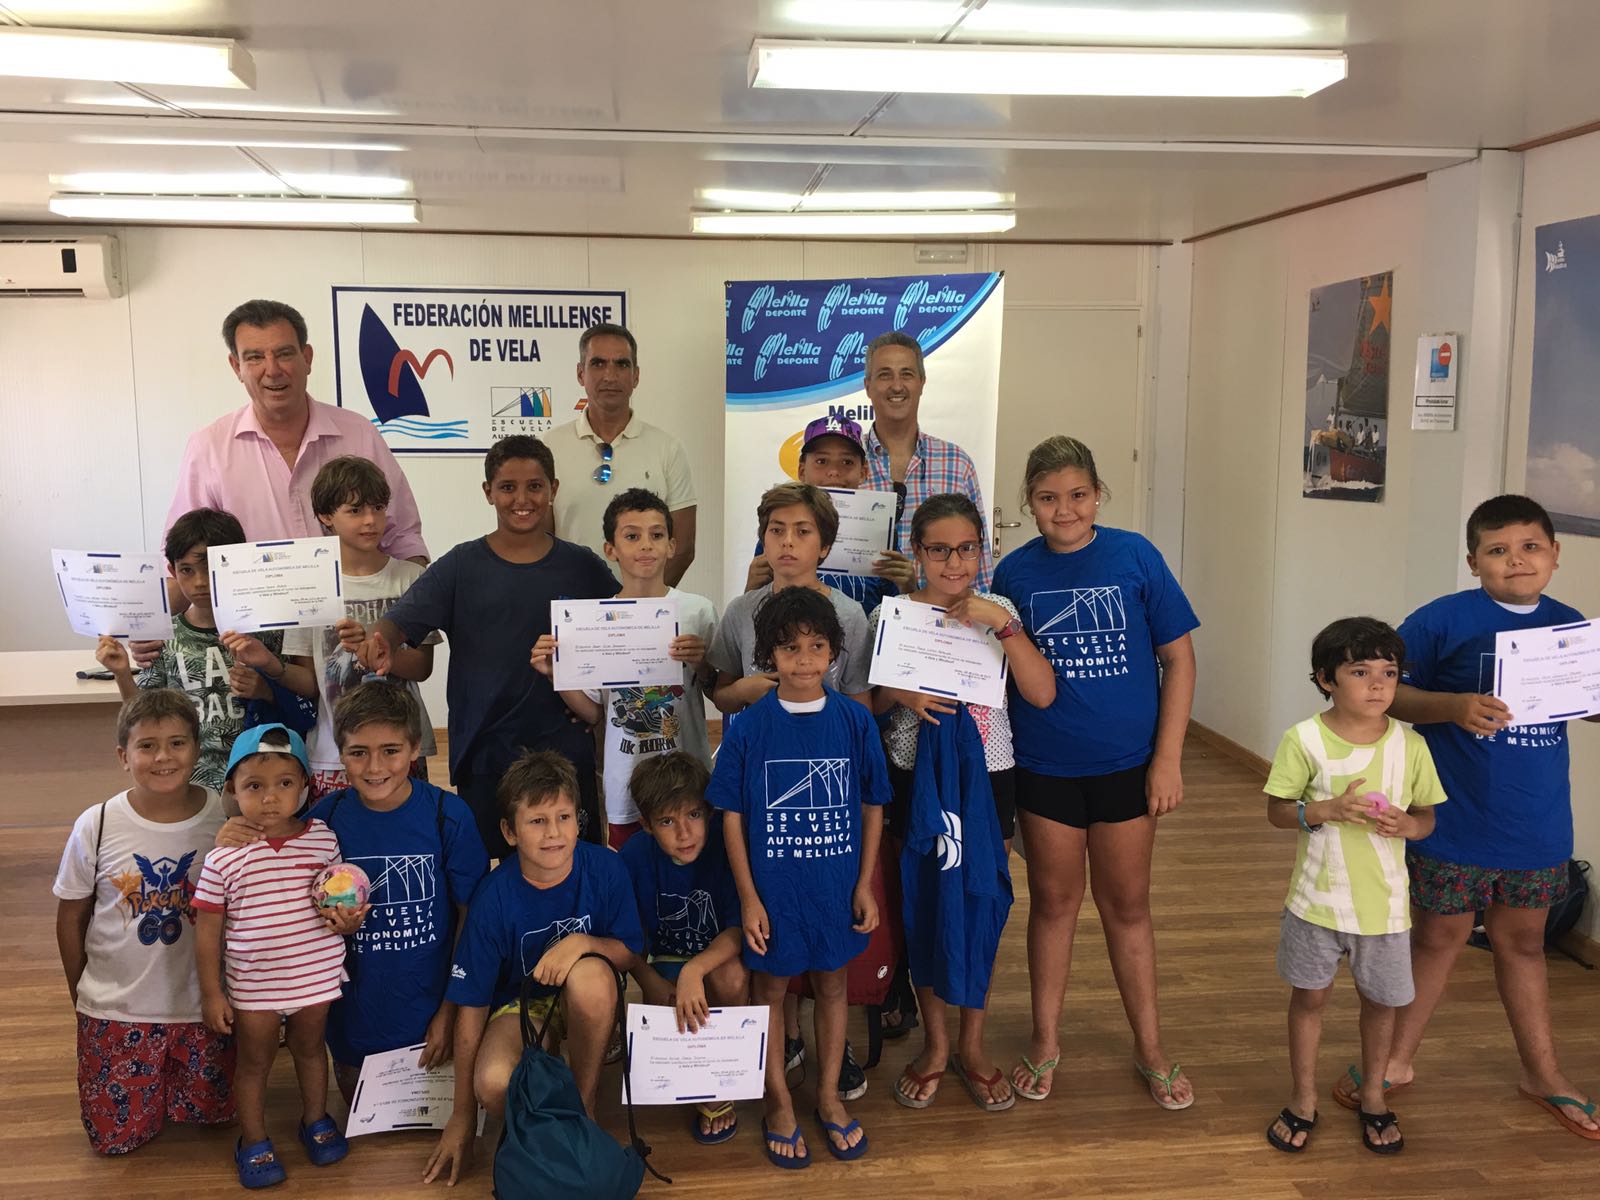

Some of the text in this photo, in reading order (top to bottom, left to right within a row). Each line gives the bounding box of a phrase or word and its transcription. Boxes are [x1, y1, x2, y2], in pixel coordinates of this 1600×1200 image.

[393, 299, 612, 329] FEDERACIÓN MELILLENSE
[765, 309, 807, 317] DEPORTE
[841, 307, 884, 315] DEPORTE
[470, 339, 541, 362] DE VELA
[777, 357, 819, 365] DEPORTE
[829, 405, 874, 421] Melil
[826, 416, 842, 432] LA
[1080, 643, 1126, 654] VELA
[176, 646, 231, 691] LA
[1066, 666, 1129, 679] MELILLA
[766, 824, 787, 832] DE
[767, 844, 852, 858] DE MELILLA
[137, 914, 182, 945] GO
[356, 921, 435, 942] UTONOMICA
[372, 933, 437, 952] MELILLA
